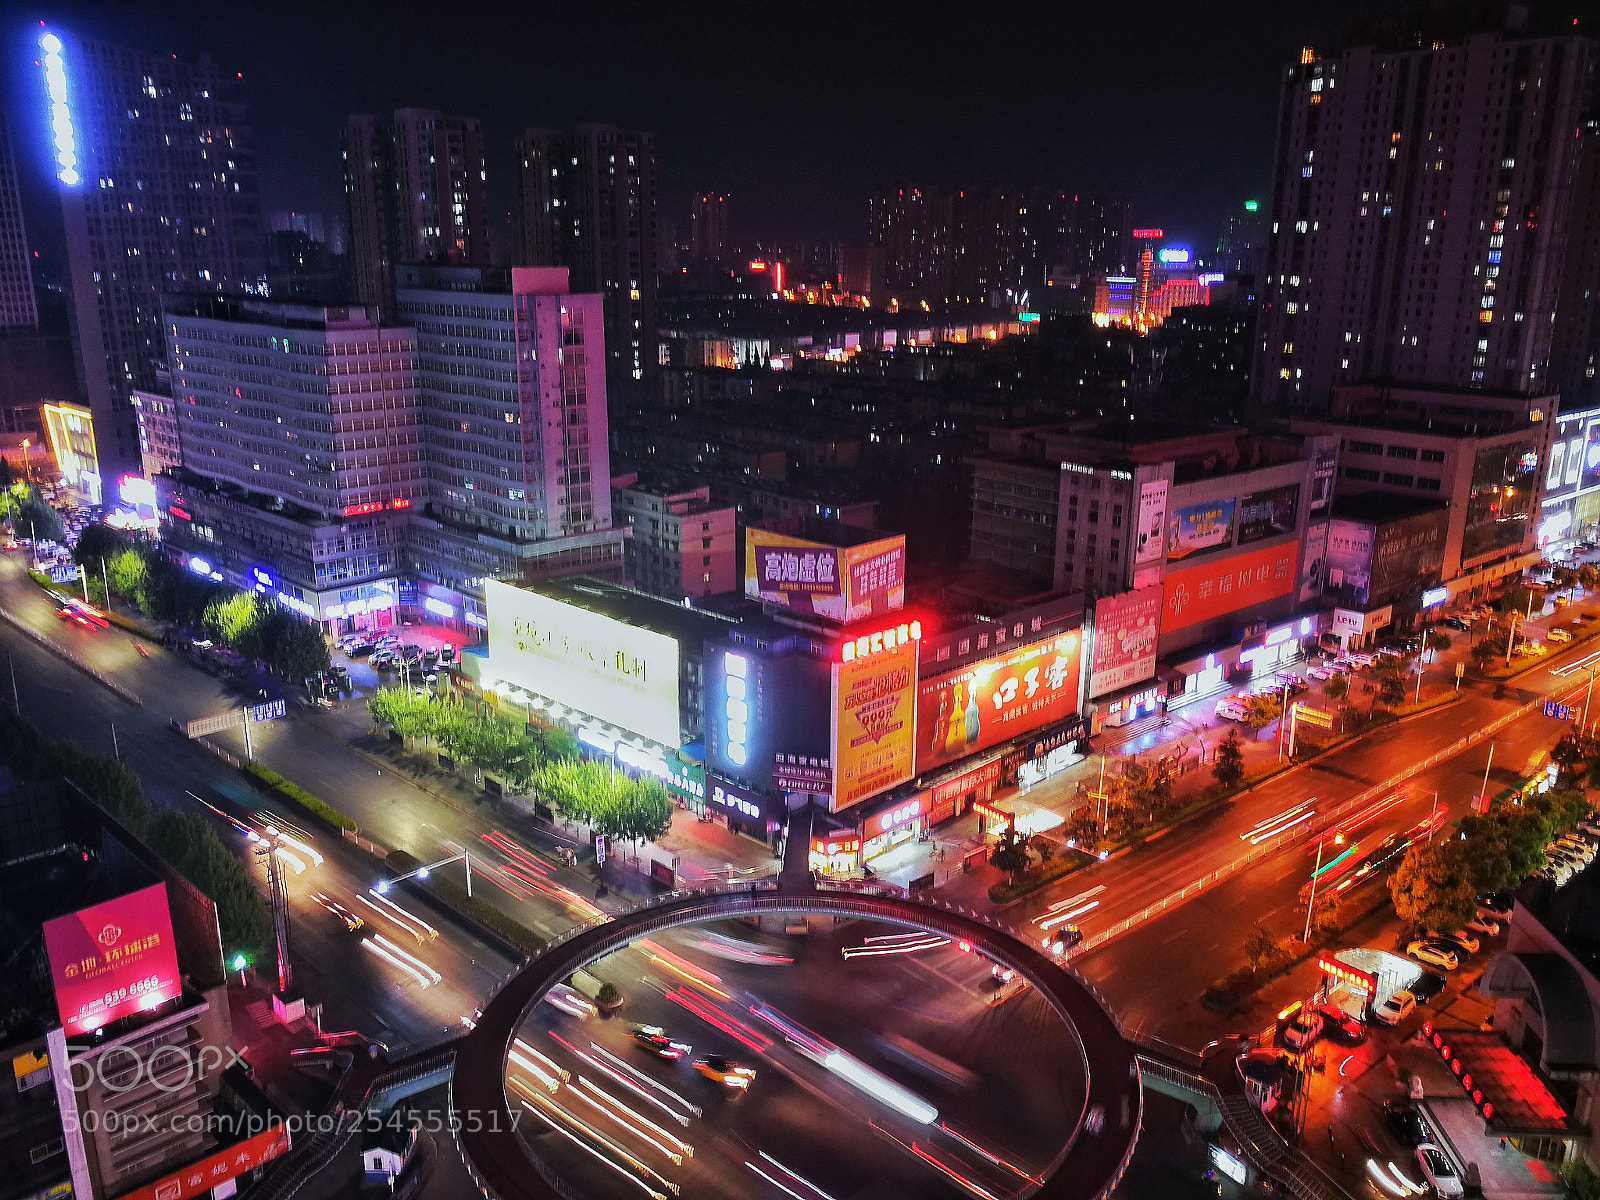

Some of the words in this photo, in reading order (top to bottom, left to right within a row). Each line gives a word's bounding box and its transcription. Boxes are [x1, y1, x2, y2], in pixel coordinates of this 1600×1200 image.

[765, 551, 835, 583] 高炮虚位
[1198, 557, 1289, 599] 幸福树电器
[104, 987, 127, 1005] 539
[129, 974, 159, 995] 6666
